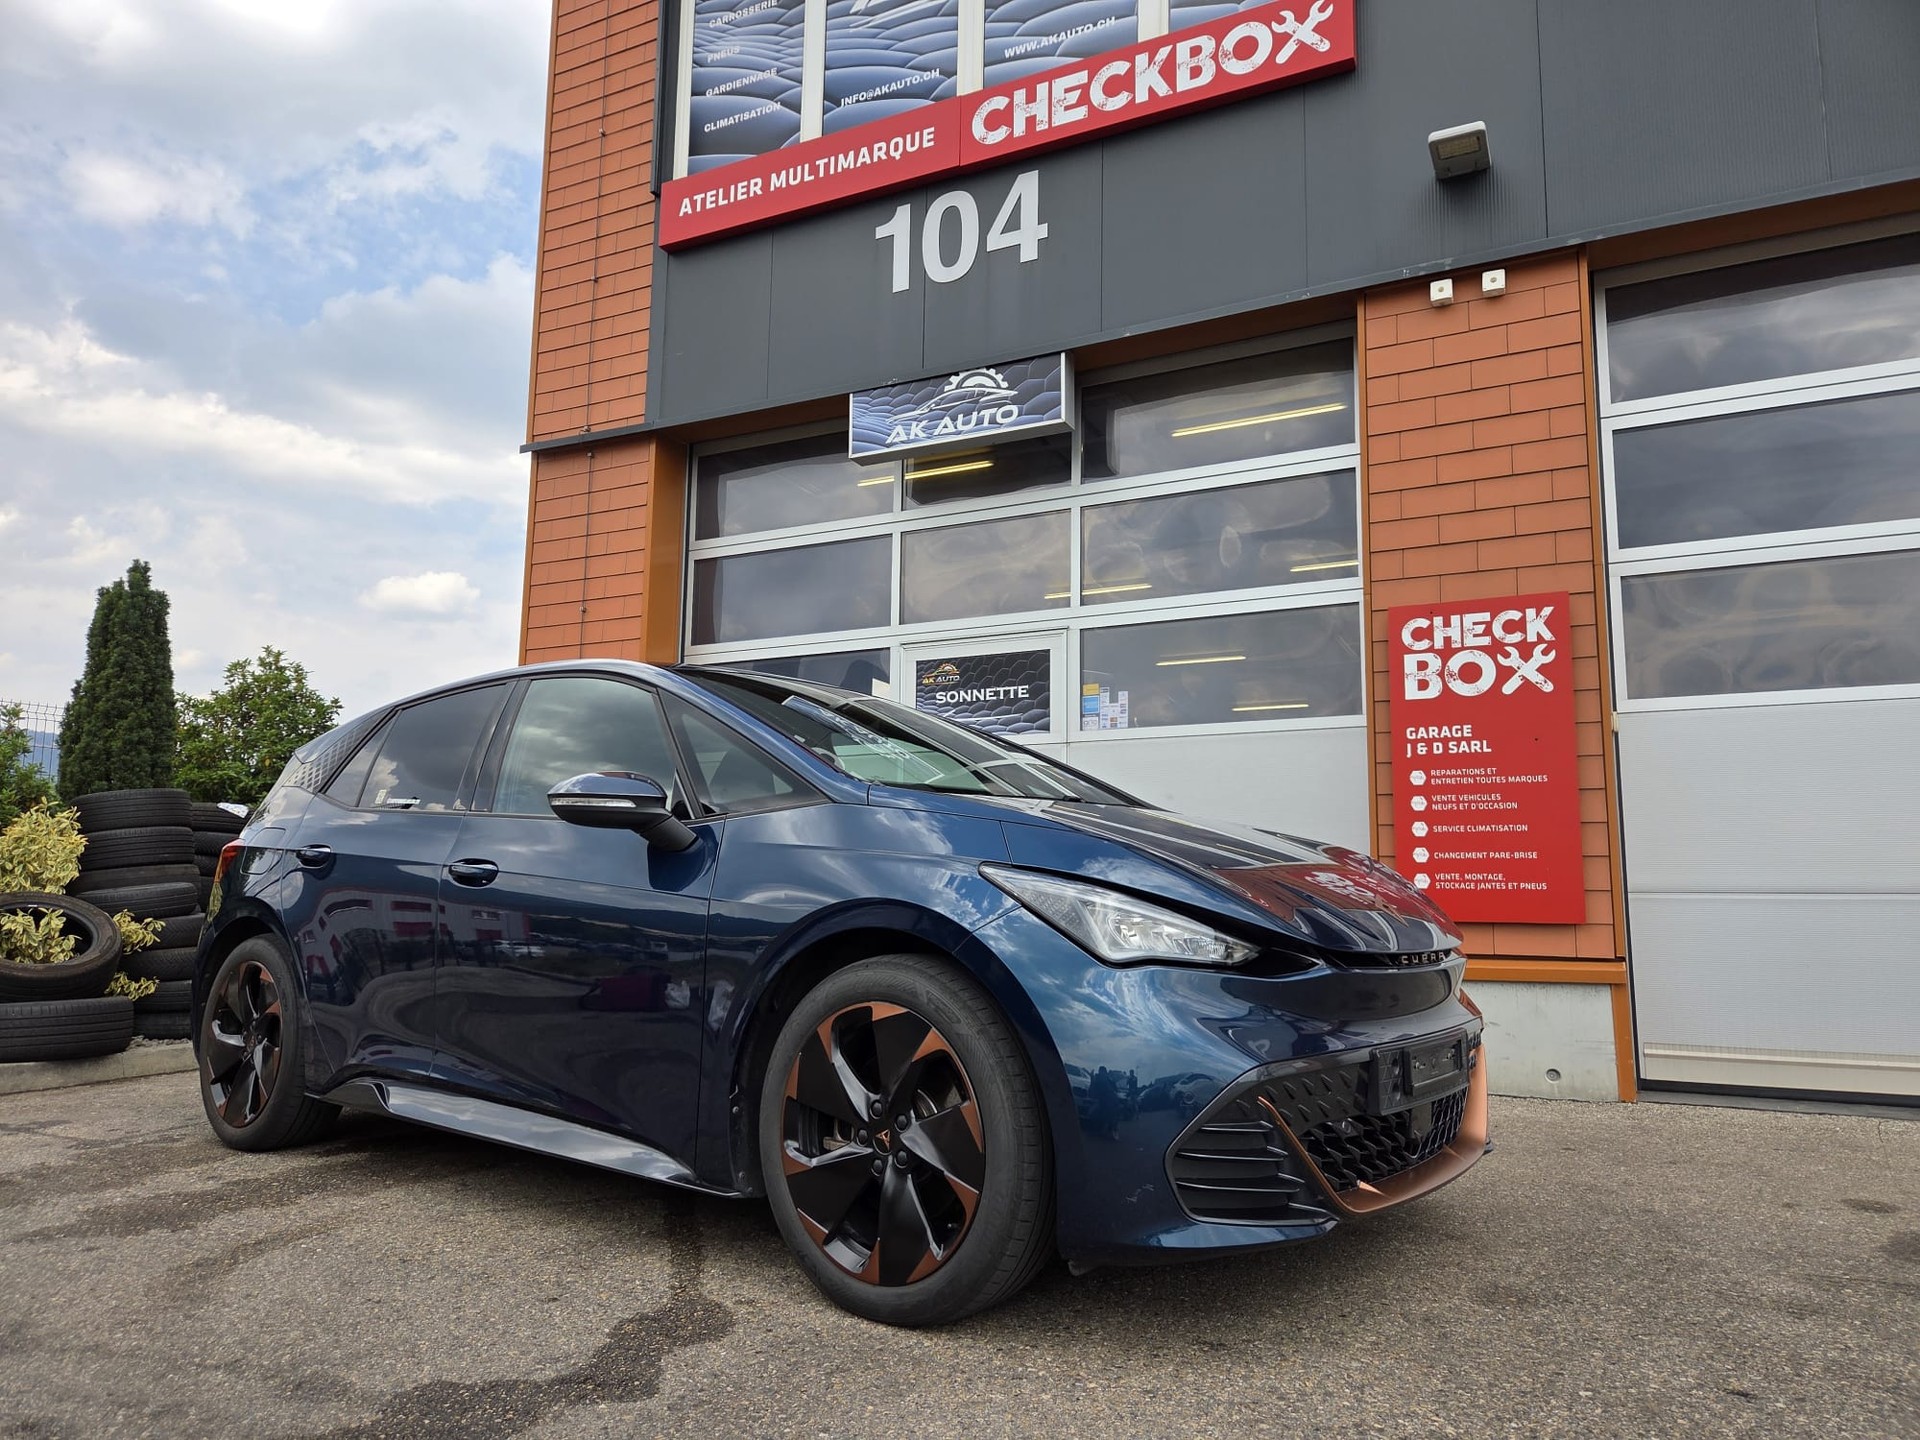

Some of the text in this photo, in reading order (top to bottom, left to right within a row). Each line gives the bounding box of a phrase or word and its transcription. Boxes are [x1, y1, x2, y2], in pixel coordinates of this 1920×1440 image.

[709, 0, 778, 28] CARROSSERIE
[1004, 16, 1116, 59] WWW.AKAUTO.CH
[707, 46, 740, 63] PNEUS
[705, 67, 778, 97] GARDIENNAGE
[840, 68, 940, 108] INFO@AKAUTO.CH
[704, 102, 781, 132] CLIMATISATION
[679, 126, 936, 217] ATELIER MULTIMARQUE
[874, 169, 1049, 293] 104
[885, 404, 1019, 444] AK AUTO
[1401, 606, 1556, 651] CHECK
[936, 675, 960, 683] AUTO
[935, 684, 1030, 704] SONNETTE
[1406, 724, 1473, 740] GARAGE
[1406, 739, 1492, 758] J & D SARL
[1430, 767, 1497, 776] REPARATIONS ET
[1431, 775, 1548, 785] ENTRETIEN TOUTES MARQUES
[1431, 793, 1502, 802] VENTE VEHICULES
[1432, 803, 1457, 811] NEUFS
[1471, 802, 1518, 810] D'OCCASION
[1433, 824, 1528, 833] SERVICE CLIMATISATION
[1489, 851, 1538, 859] PARE-BRISE
[1435, 882, 1547, 891] STOCKAGE JANTES ET PNEUS
[1401, 951, 1447, 964] CUPRA
